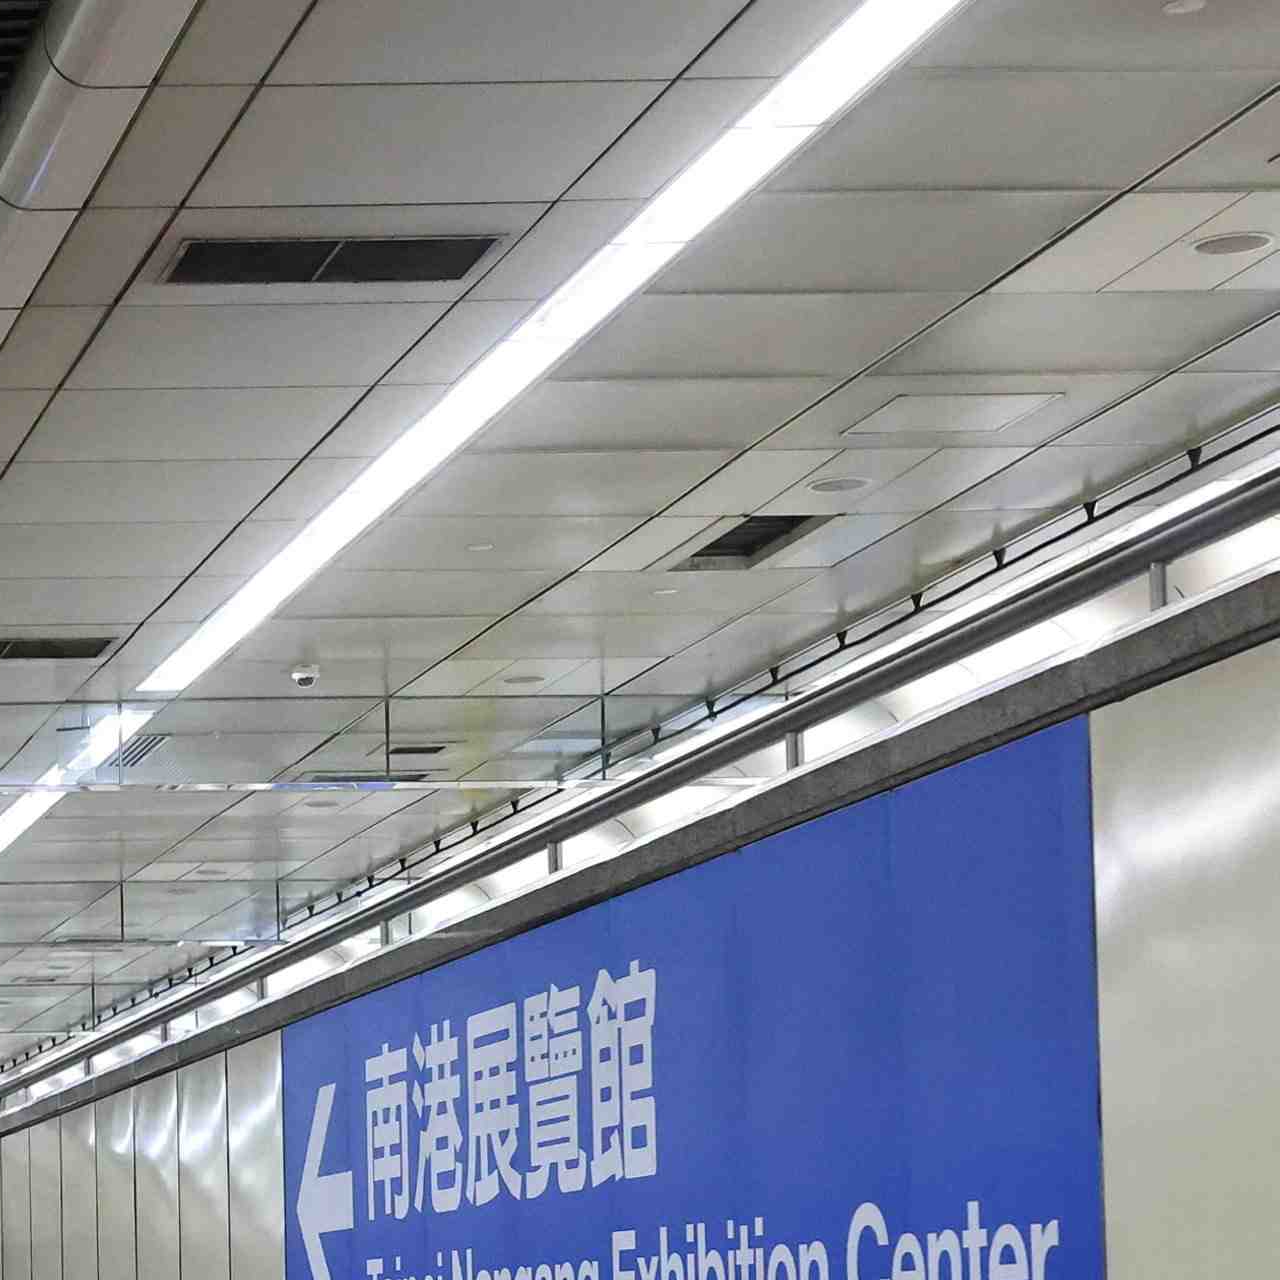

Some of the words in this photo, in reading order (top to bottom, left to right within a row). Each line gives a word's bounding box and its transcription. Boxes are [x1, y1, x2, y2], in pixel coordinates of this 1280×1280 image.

[365, 958, 656, 1221] 南港展覽館
